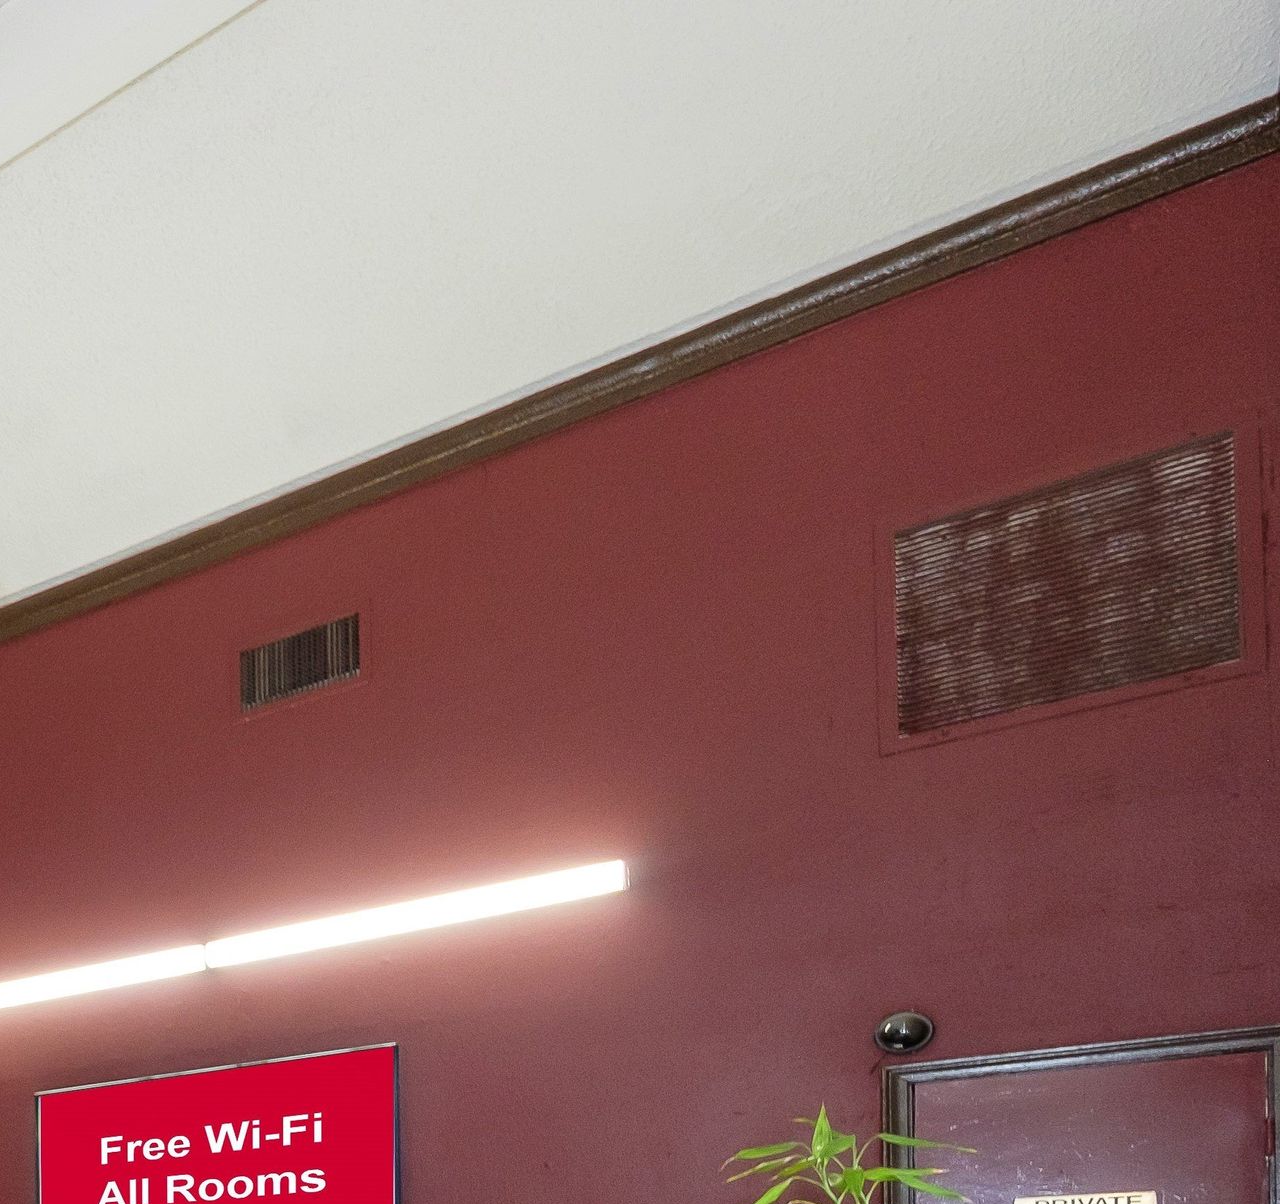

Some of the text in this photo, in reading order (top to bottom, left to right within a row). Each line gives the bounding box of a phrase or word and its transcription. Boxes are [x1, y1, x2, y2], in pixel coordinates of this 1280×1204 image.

[100, 1112, 322, 1165] Free Wi-Fi
[166, 1168, 327, 1204] Rooms
